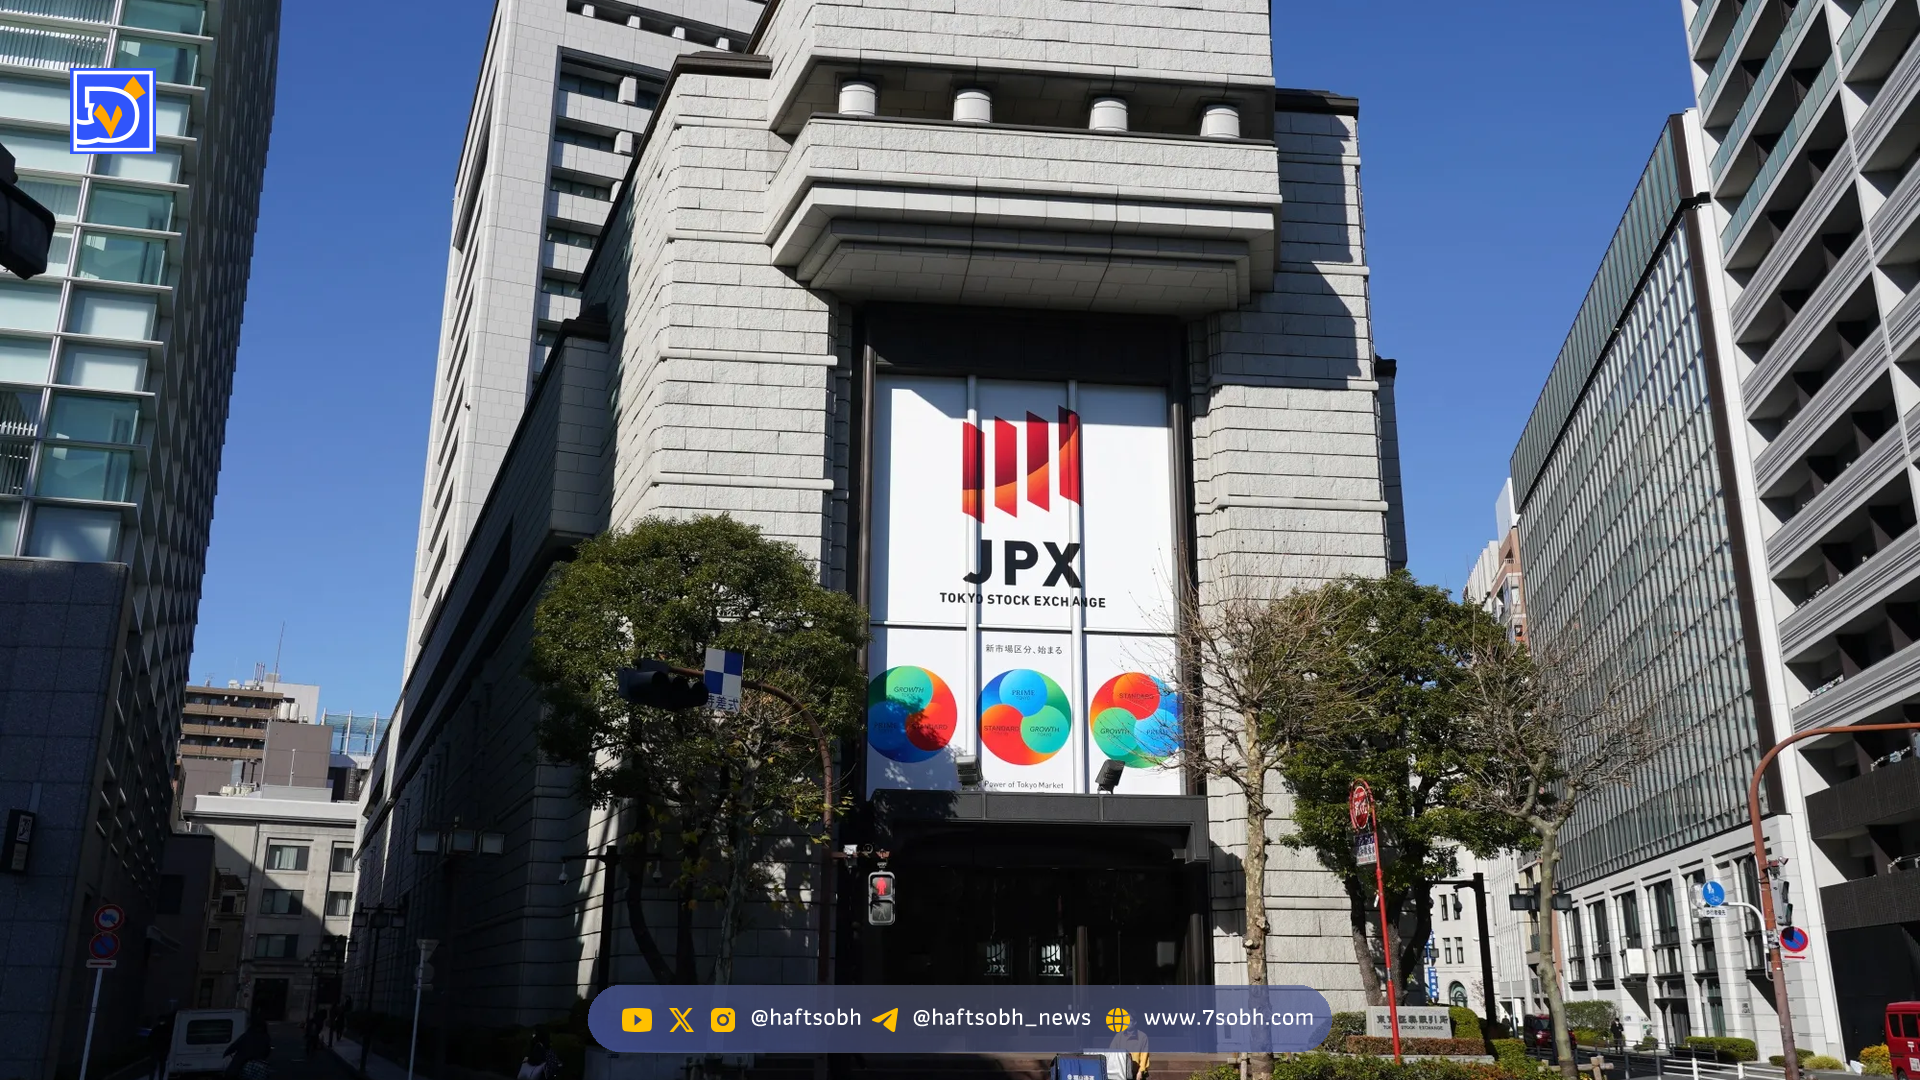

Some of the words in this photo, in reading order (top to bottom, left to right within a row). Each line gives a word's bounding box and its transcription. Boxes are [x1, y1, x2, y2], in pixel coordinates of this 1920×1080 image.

[963, 540, 1083, 588] JPX
[940, 592, 983, 605] TOKYO
[987, 594, 1030, 606] STOCK
[1034, 595, 1106, 608] EXCHANGE
[985, 644, 1063, 655] 新市場区分、始まる
[985, 780, 1006, 788] Power
[1017, 781, 1037, 789] Tokyo
[987, 965, 1006, 973] JPX
[1042, 965, 1060, 974] JPX
